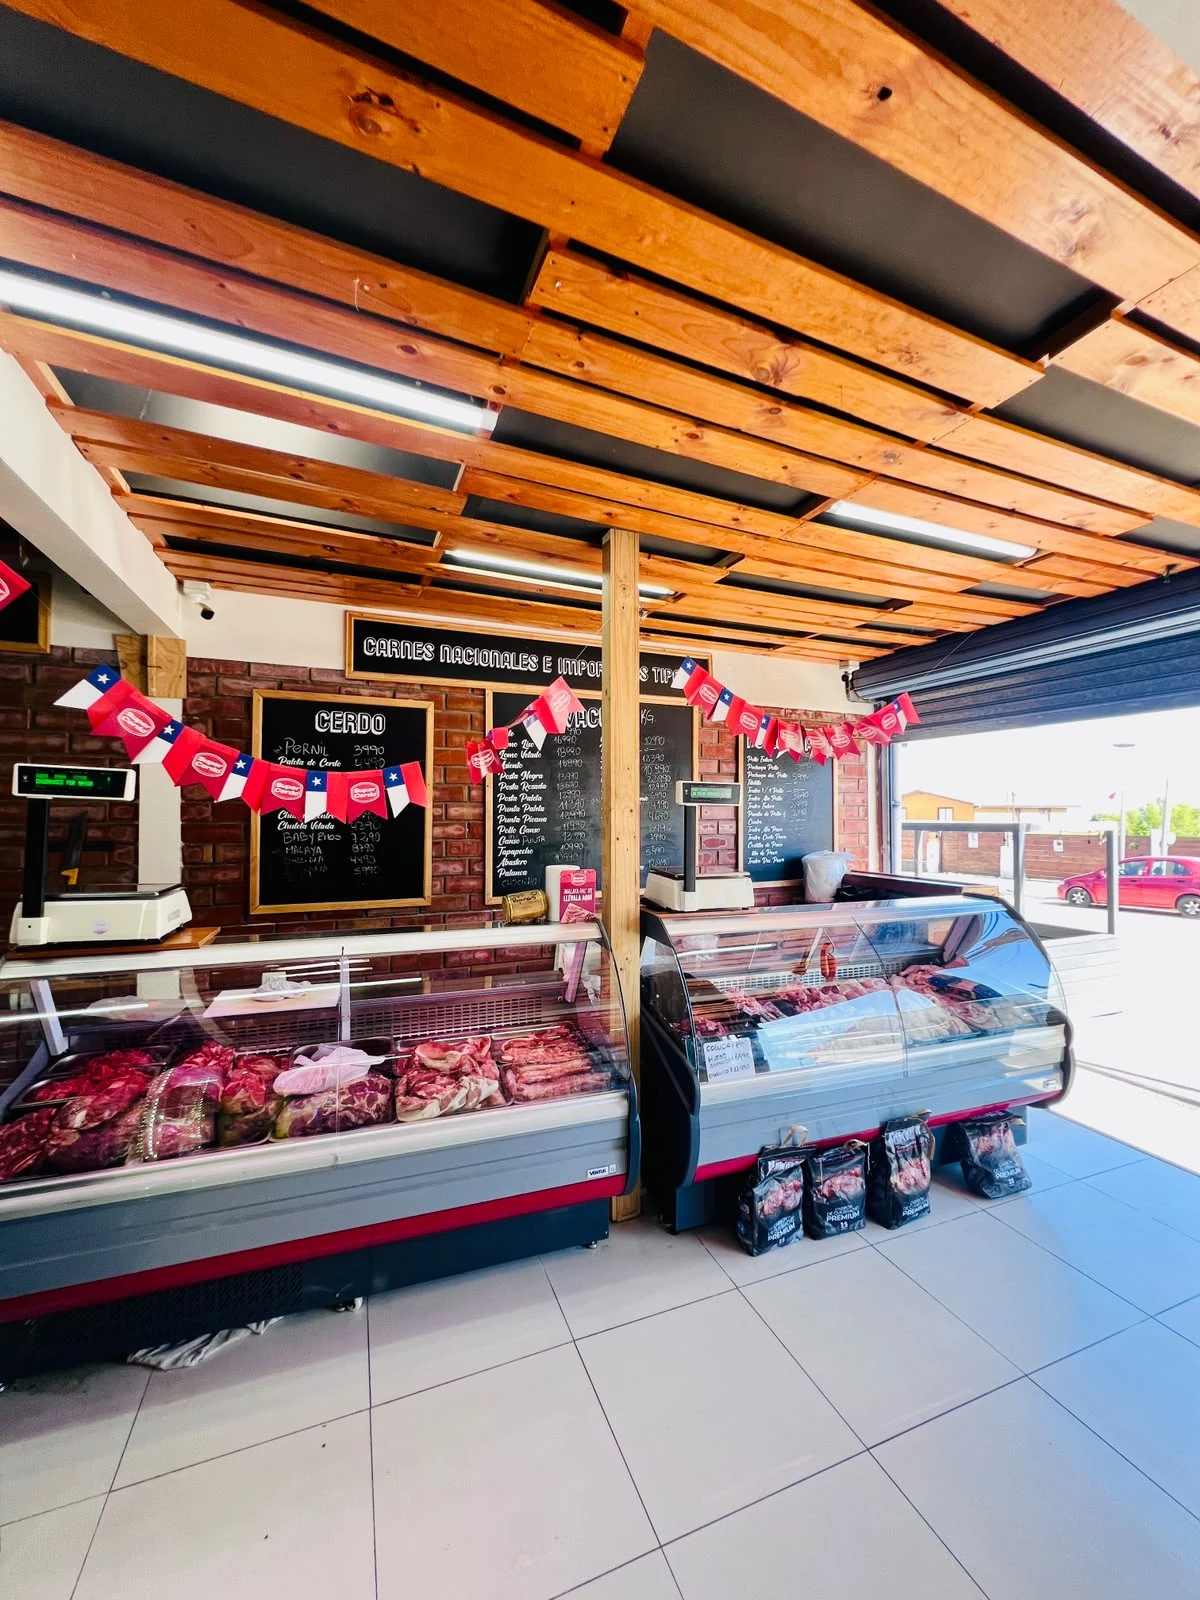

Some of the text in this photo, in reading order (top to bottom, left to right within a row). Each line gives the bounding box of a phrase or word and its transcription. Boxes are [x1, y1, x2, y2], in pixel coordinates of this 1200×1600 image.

[363, 636, 435, 661] CARNES
[440, 643, 539, 672] NACIONALES
[542, 655, 553, 673] E
[121, 716, 147, 734] Cerdo
[125, 711, 151, 730] Super
[315, 709, 386, 735] CERDO
[520, 739, 535, 750] Liso
[353, 744, 386, 757] 3990
[499, 749, 519, 760] Lomo
[520, 749, 542, 760] Velado
[197, 756, 223, 769] Super
[277, 755, 305, 766] Paleta
[306, 758, 317, 767] de
[318, 758, 342, 768] Cerdo
[196, 761, 221, 774] Cerdo
[498, 771, 519, 781] Posta
[520, 770, 544, 781] Negra
[274, 787, 299, 797] Cerdo
[275, 782, 301, 792] Super
[498, 782, 520, 791] Posta
[497, 793, 518, 802] Posta
[519, 793, 543, 802] Paleta
[497, 803, 520, 813] Punta
[522, 803, 545, 813] Paleta
[497, 814, 520, 824] Punta
[277, 821, 307, 830] Chuleta
[310, 820, 335, 831] Velada
[497, 825, 517, 835] Pollo
[519, 825, 541, 835] Ganso
[282, 831, 314, 845] BABY
[498, 836, 520, 846] Ganso
[497, 846, 534, 857] Tapapecho
[496, 858, 528, 868] Abastero
[497, 868, 529, 878] Palanca
[826, 1210, 860, 1222] PREMIUM
